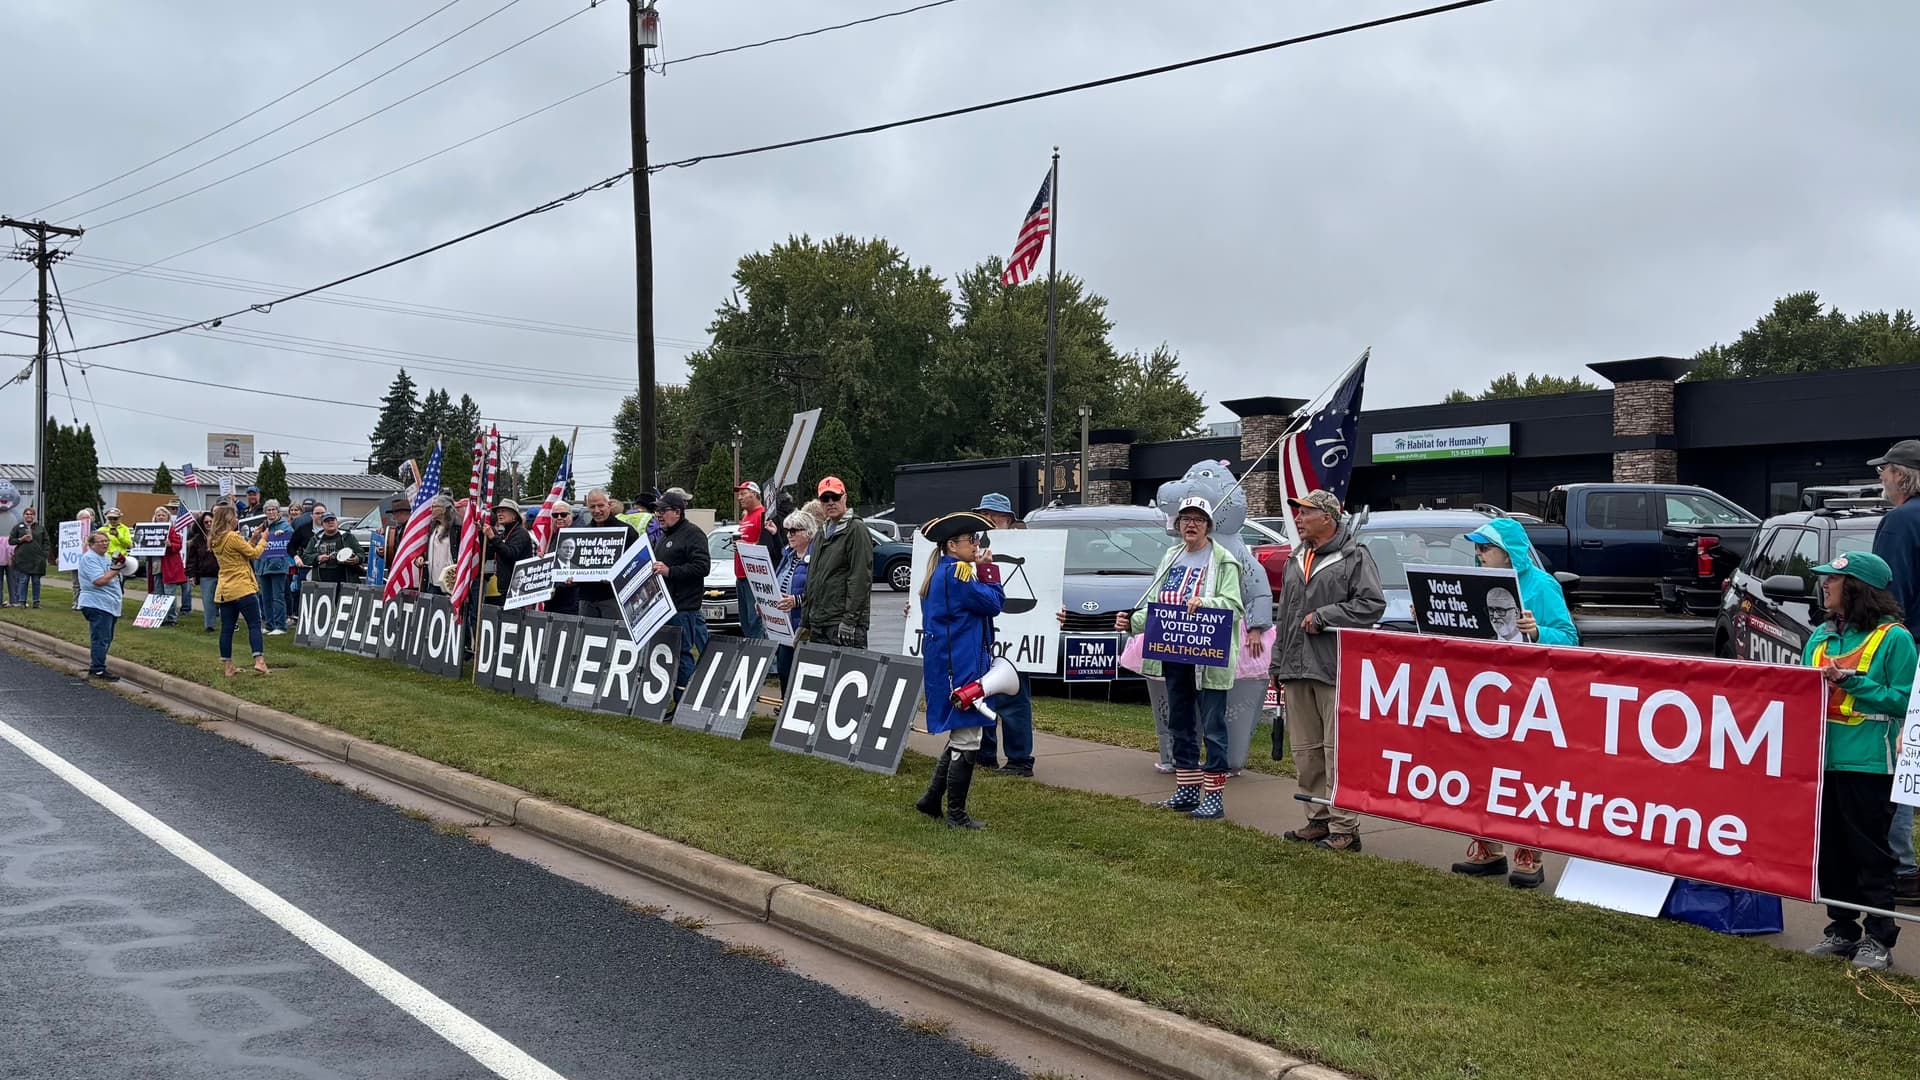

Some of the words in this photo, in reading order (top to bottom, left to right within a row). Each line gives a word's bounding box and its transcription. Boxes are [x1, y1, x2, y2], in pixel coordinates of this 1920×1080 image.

[1315, 428, 1349, 468] 76
[1407, 439, 1435, 450] Habitat
[1436, 438, 1447, 448] for
[1449, 436, 1487, 447] Humanity
[576, 537, 597, 547] Voted
[597, 537, 624, 548] Against
[580, 547, 592, 555] the
[593, 547, 616, 556] Voting
[579, 556, 601, 567] Rights
[601, 556, 614, 565] Act
[750, 581, 774, 595] TIFFANY
[1428, 579, 1463, 595] Voted
[1430, 595, 1447, 610] for
[1448, 597, 1469, 612] the
[1154, 608, 1177, 620] TOM
[1180, 611, 1226, 625] TIFFANY
[1427, 611, 1458, 627] SAVE
[1460, 614, 1479, 629] Act
[1161, 620, 1198, 633] VOTED
[1200, 624, 1216, 634] TO
[1162, 632, 1185, 643] CUT
[1187, 635, 1212, 646] OUR
[1016, 635, 1045, 664] All
[1149, 642, 1225, 659] HEALTHCARE
[477, 619, 674, 705] DENIERS
[692, 651, 767, 719] IN
[1068, 655, 1115, 668] TIFFANY
[1359, 658, 1568, 749] MAGA
[1589, 681, 1785, 778] TOM
[1381, 749, 1470, 807] Too
[1486, 766, 1748, 857] Extreme
